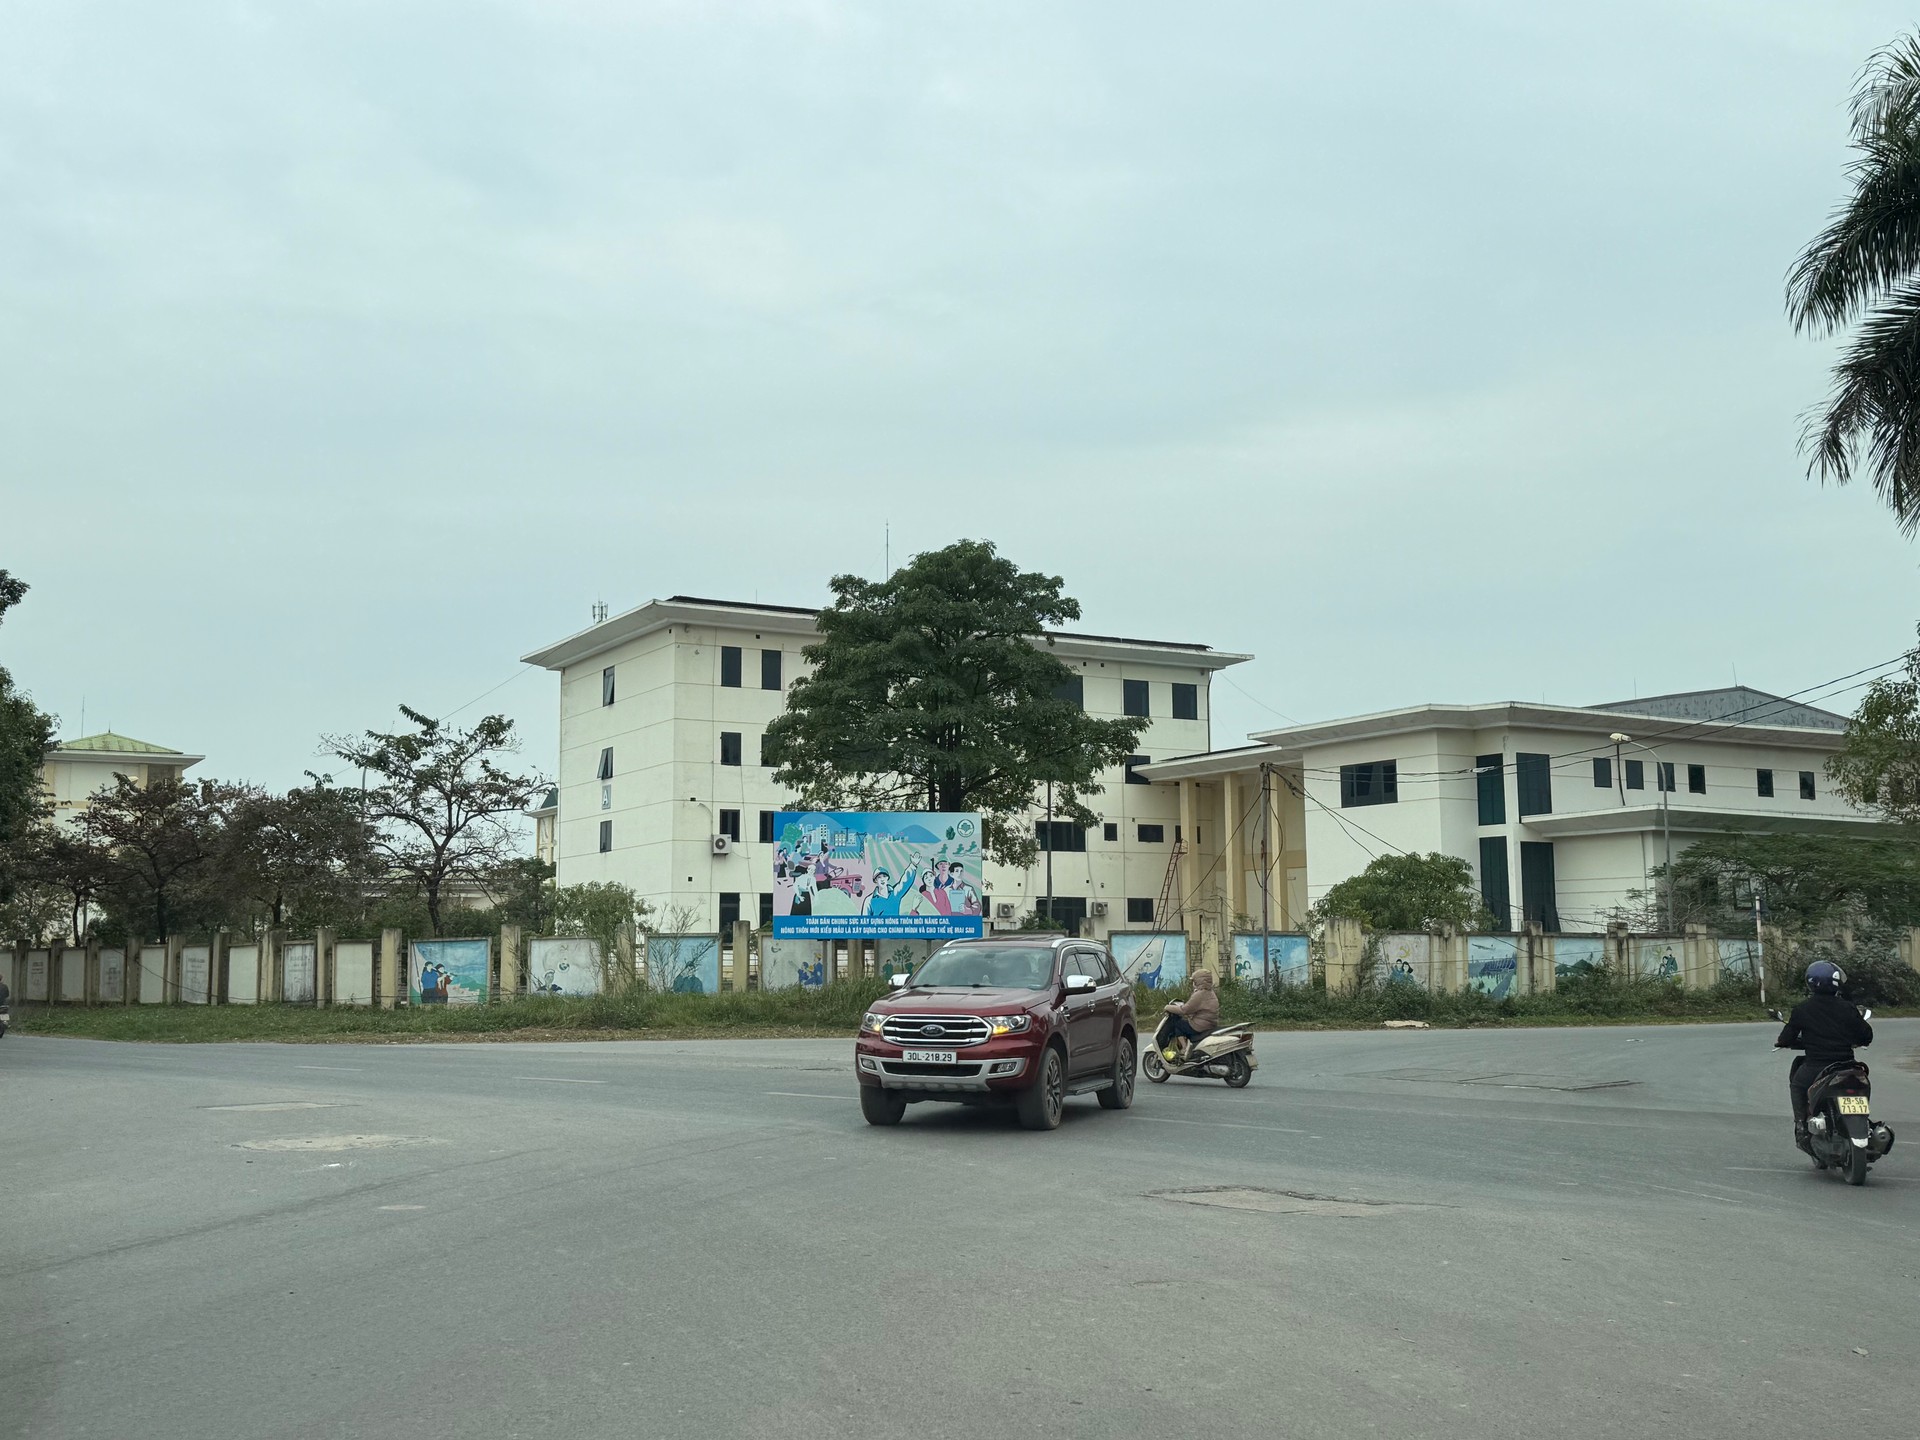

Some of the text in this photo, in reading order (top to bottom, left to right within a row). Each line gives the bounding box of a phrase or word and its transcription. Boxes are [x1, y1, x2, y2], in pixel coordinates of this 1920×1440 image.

[796, 925, 809, 933] THÔN
[852, 925, 862, 933] XÂY
[878, 925, 888, 933] CHO
[926, 925, 936, 933] CHO
[907, 1052, 952, 1062] 30L-218.29
[1841, 1105, 1868, 1113] 713.17
